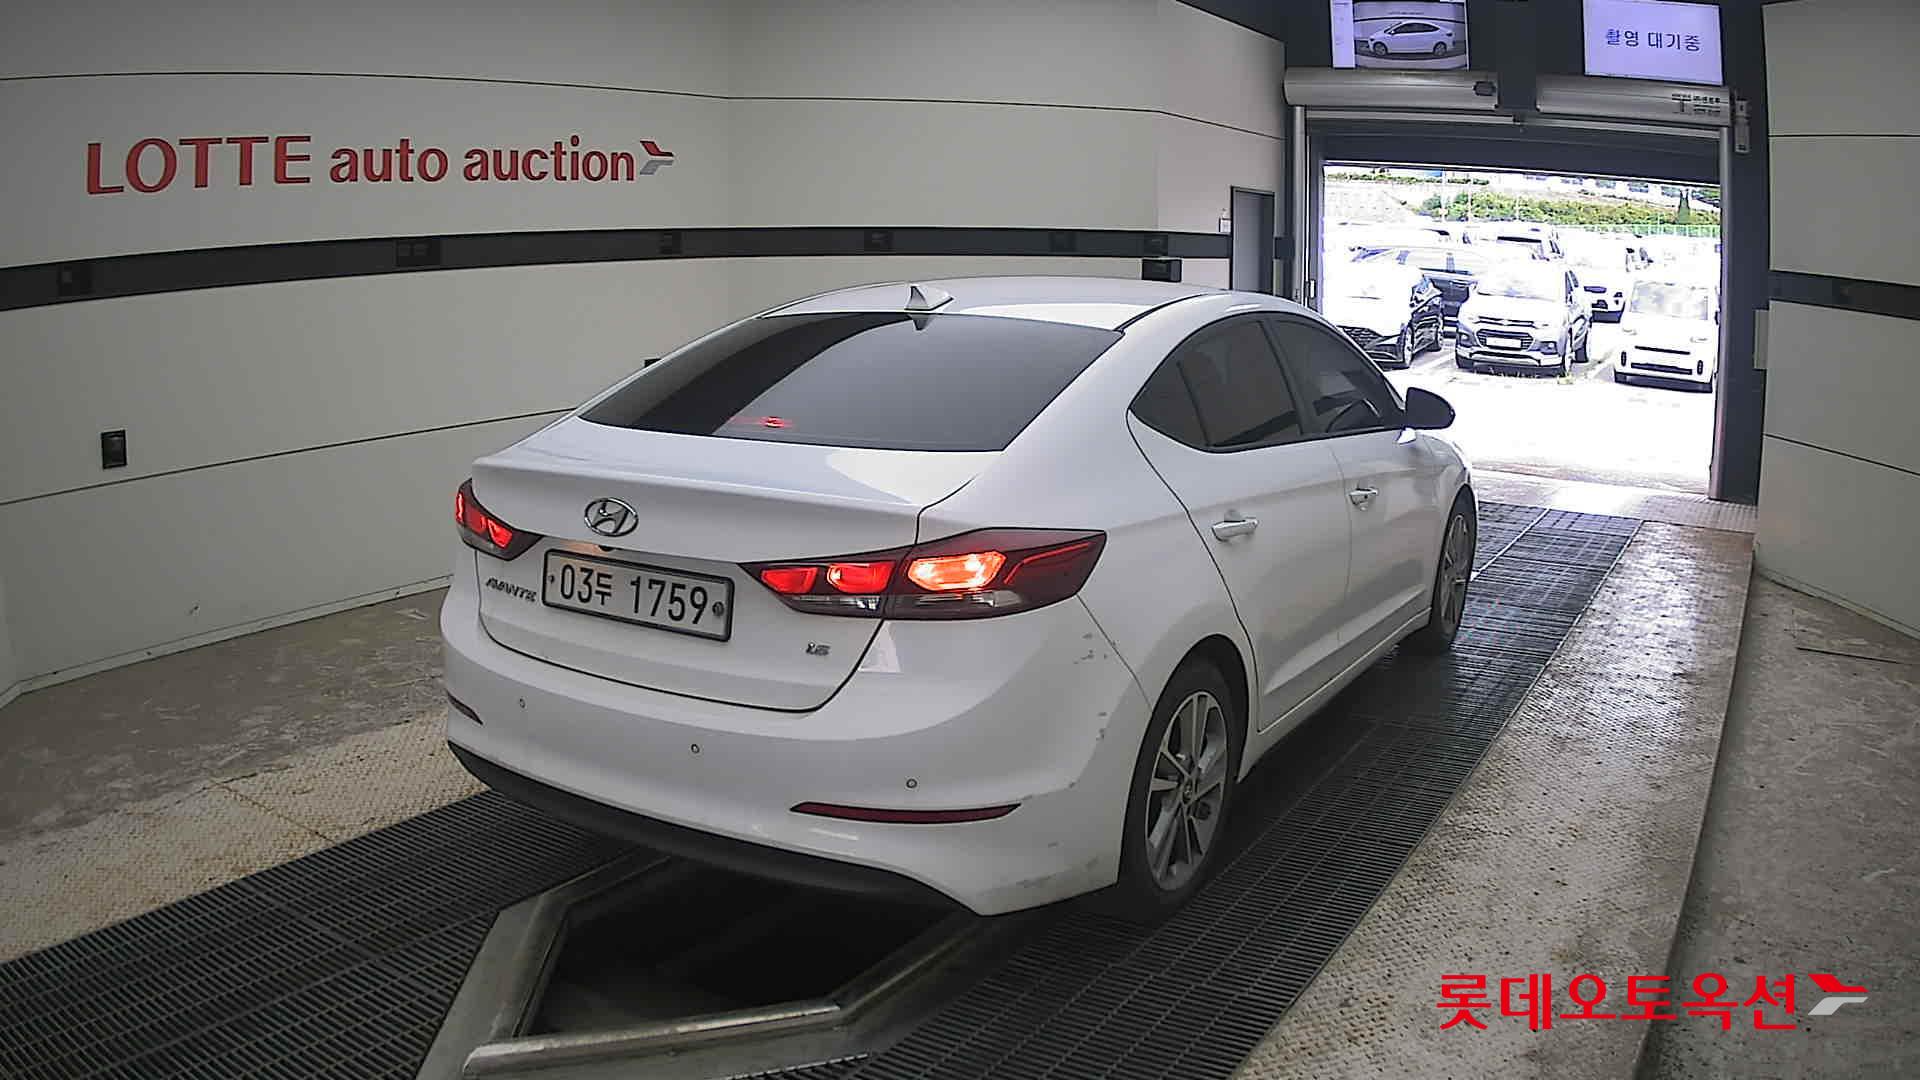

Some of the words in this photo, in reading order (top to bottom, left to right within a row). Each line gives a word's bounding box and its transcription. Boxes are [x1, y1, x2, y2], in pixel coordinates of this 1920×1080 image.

[1647, 32, 1700, 52] 대기중
[87, 136, 310, 194] LOTTE
[330, 138, 448, 182] auto
[463, 135, 636, 181] auction
[561, 564, 613, 606] 03두
[630, 576, 708, 624] 1759
